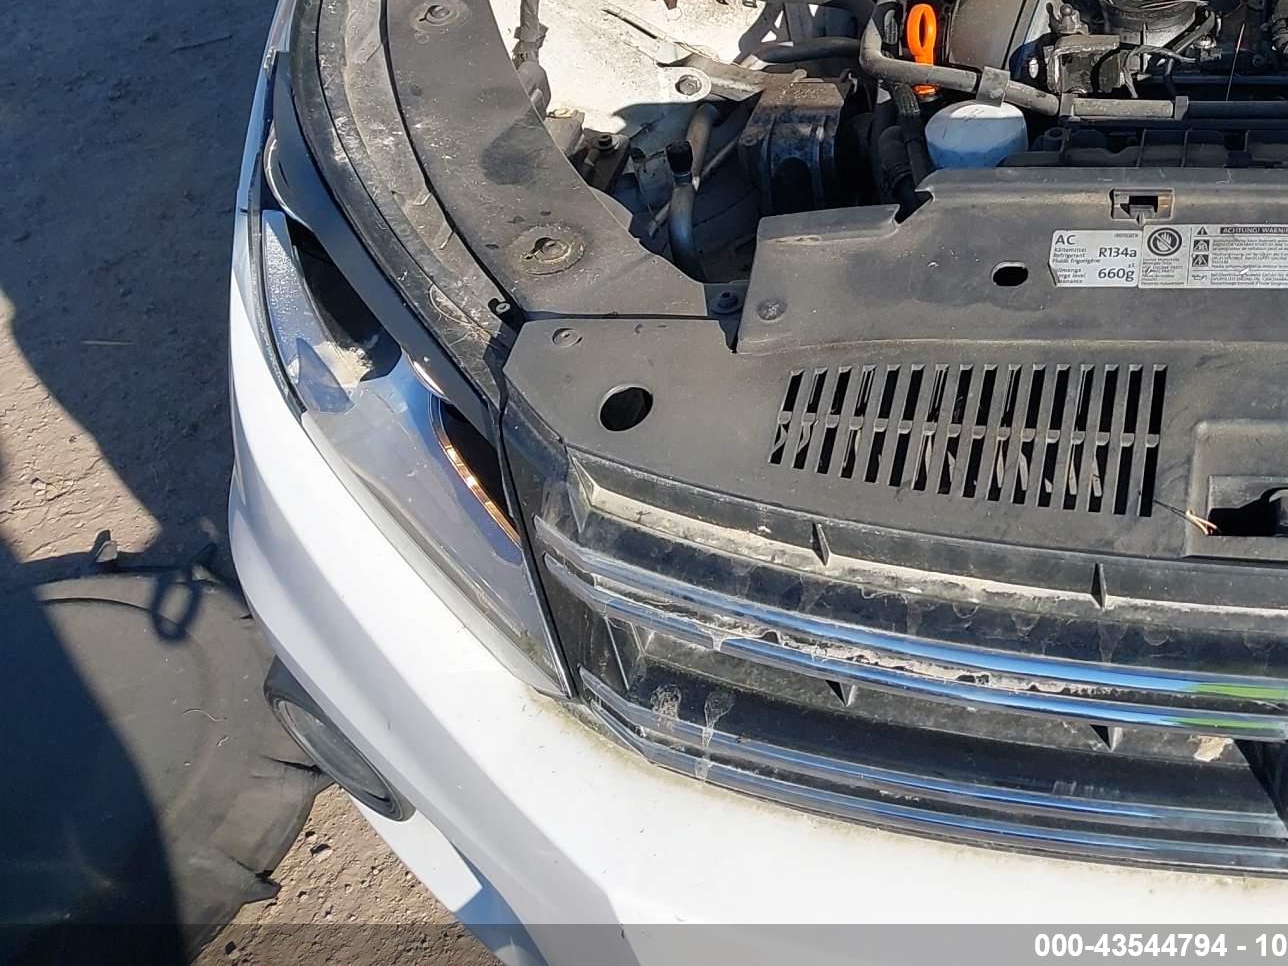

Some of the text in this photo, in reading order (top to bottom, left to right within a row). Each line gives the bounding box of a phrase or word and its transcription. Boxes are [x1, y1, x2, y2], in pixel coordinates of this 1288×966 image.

[1055, 235, 1076, 245] AC
[1099, 248, 1137, 258] R134a
[1098, 268, 1135, 283] 660g
